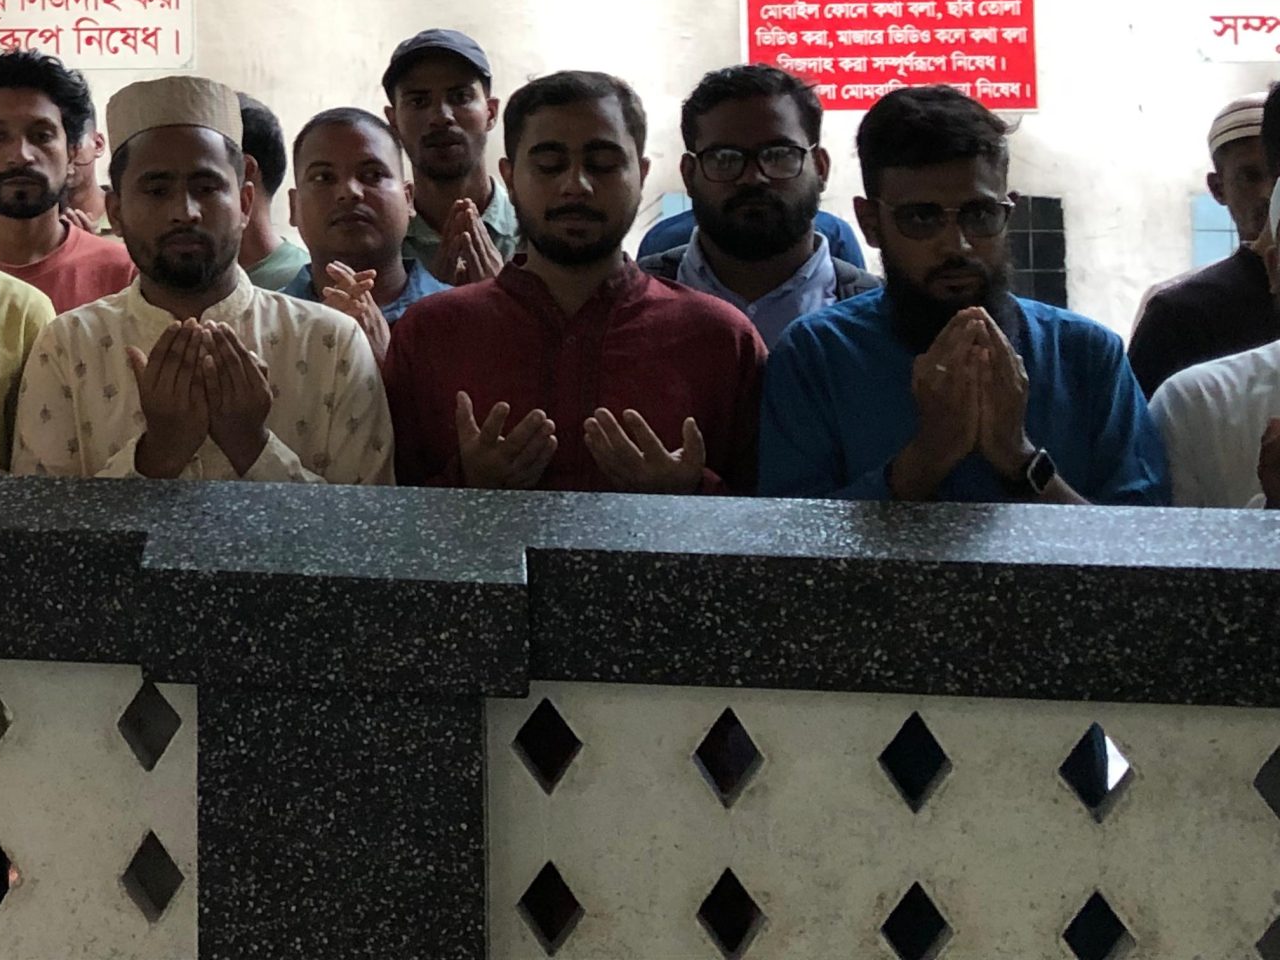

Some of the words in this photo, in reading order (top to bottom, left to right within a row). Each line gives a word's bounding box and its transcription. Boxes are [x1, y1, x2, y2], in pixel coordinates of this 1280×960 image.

[760, 0, 821, 20] মোবাইল
[824, 3, 868, 19] ফোনে
[871, 2, 903, 18] কথা
[978, 0, 1022, 16] তোলা
[836, 29, 885, 45] মাজারে
[969, 28, 998, 43] কথা
[1001, 27, 1028, 43] বলা
[837, 56, 868, 73] করা
